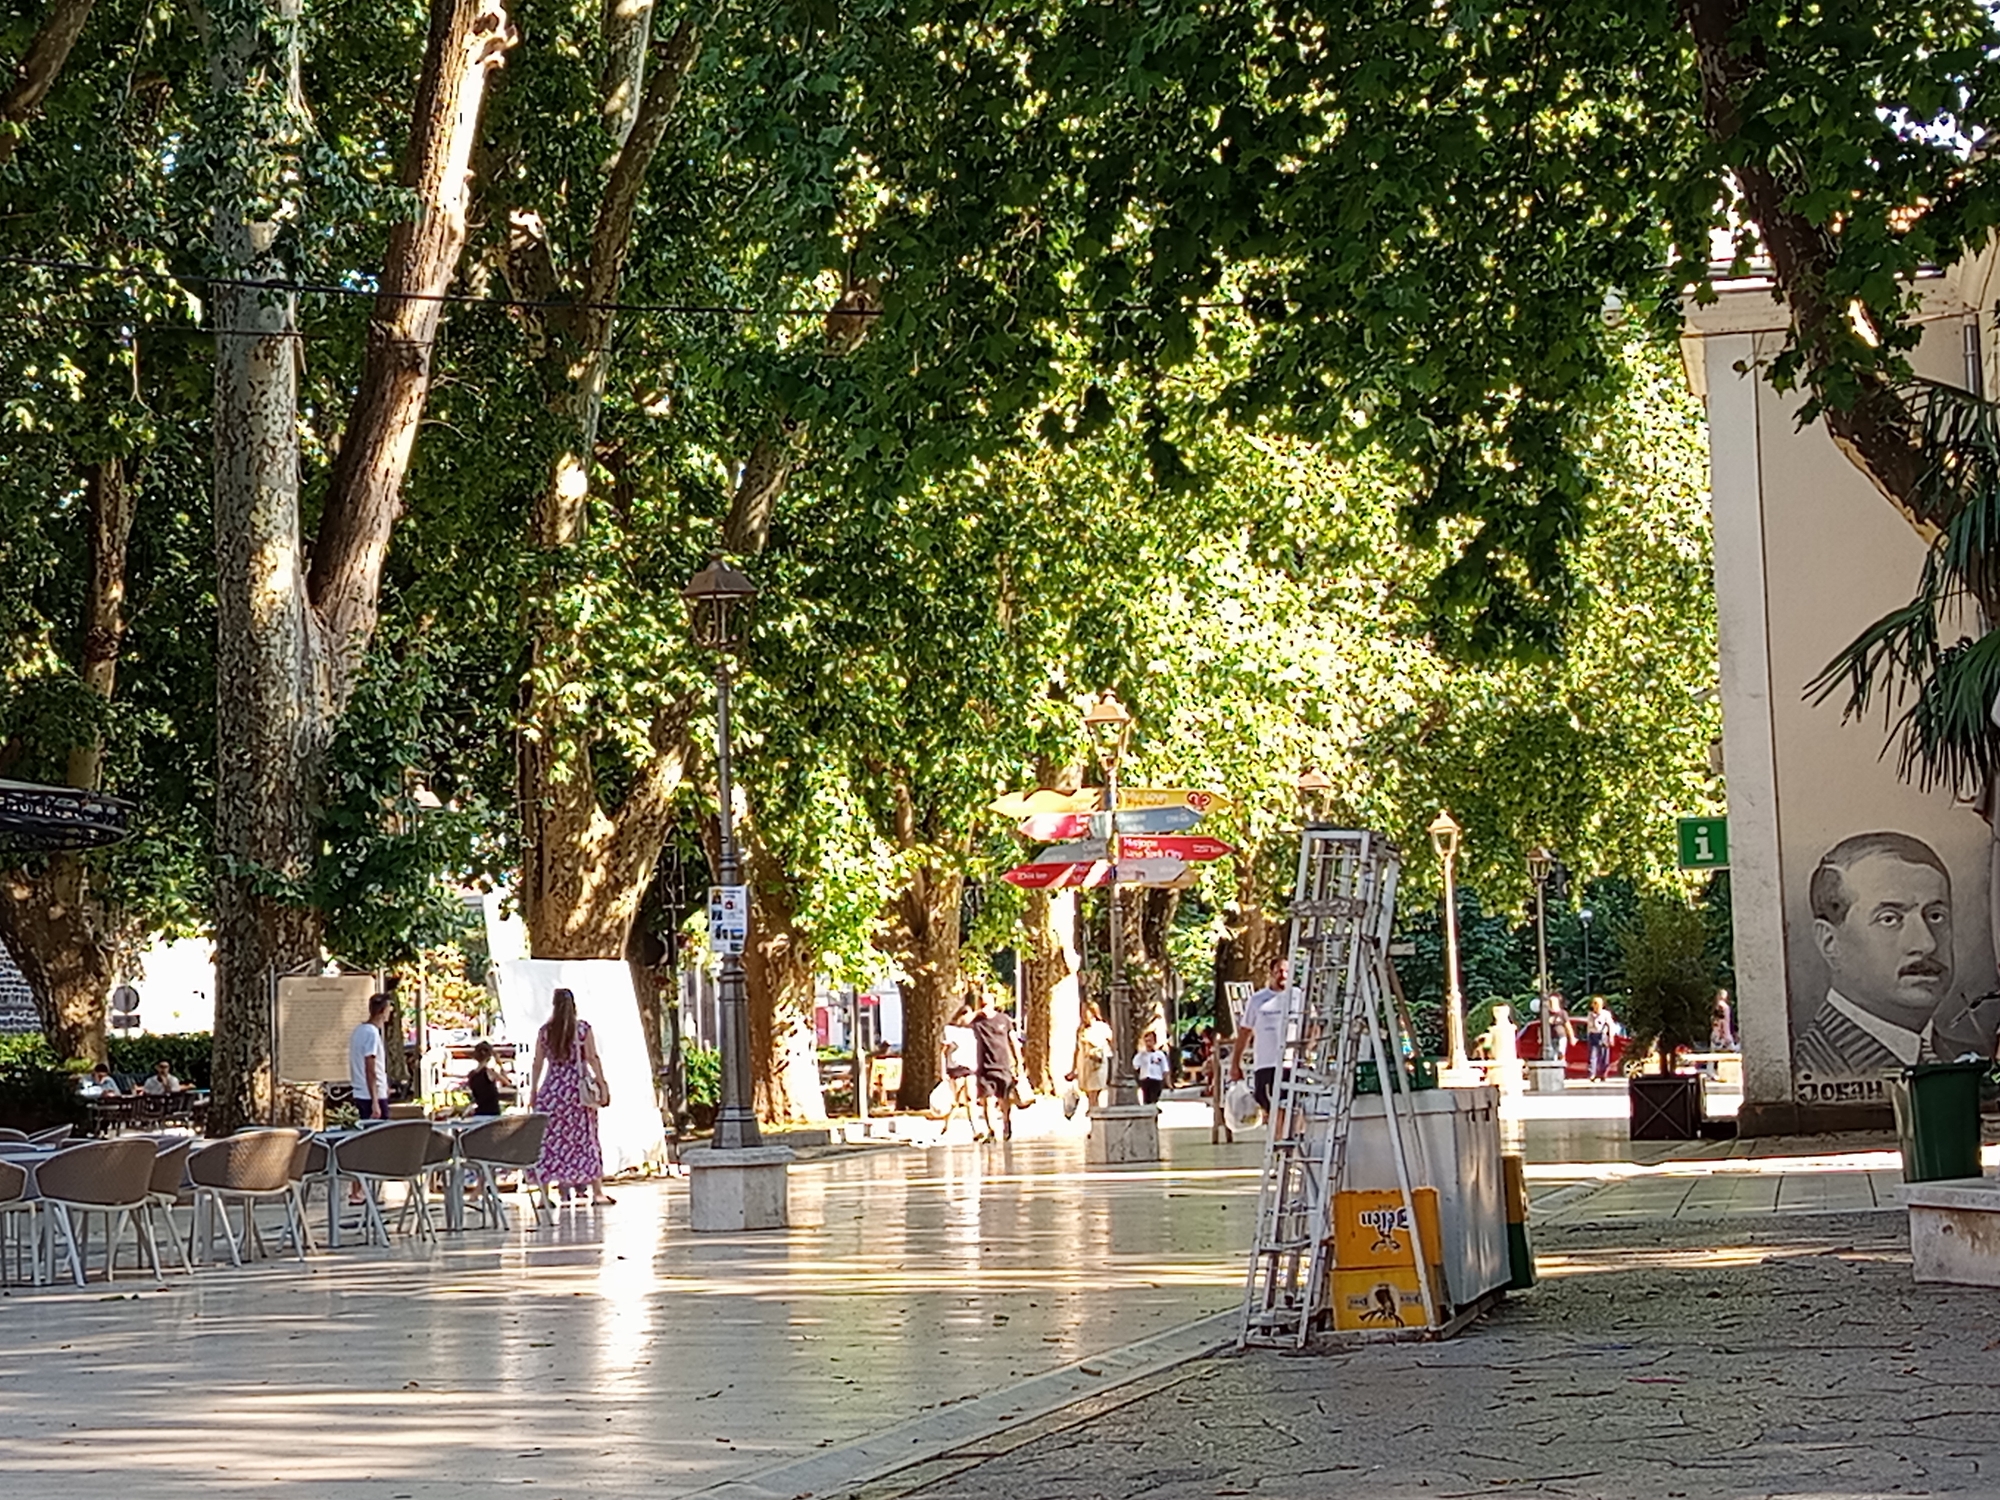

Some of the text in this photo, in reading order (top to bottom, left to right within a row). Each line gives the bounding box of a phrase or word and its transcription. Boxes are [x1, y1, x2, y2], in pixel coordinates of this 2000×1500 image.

[1144, 849, 1164, 859] York
[1165, 848, 1184, 860] City
[1361, 1208, 1410, 1230] Jelen
